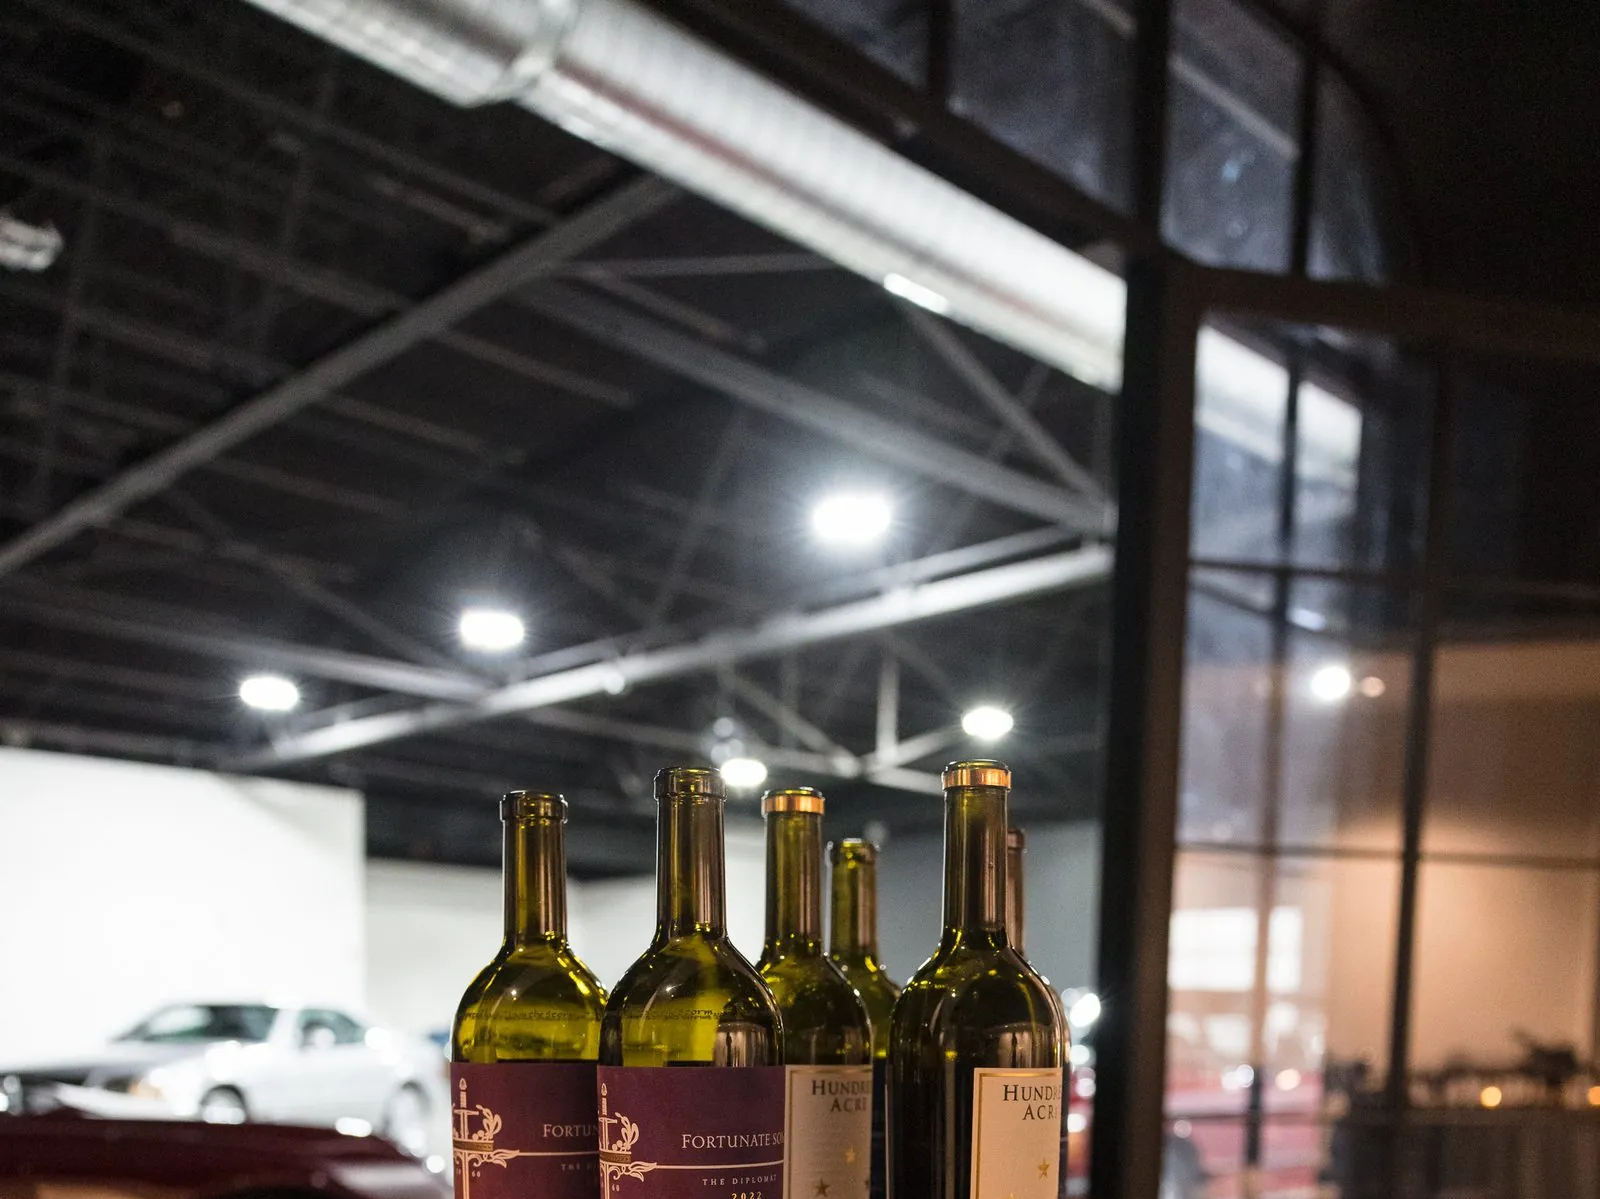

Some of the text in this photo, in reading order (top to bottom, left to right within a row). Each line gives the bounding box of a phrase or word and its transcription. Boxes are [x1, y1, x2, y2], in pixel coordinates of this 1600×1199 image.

[681, 1133, 770, 1149] FORTUNATE
[702, 1174, 777, 1186] THE DIPLOMAT
